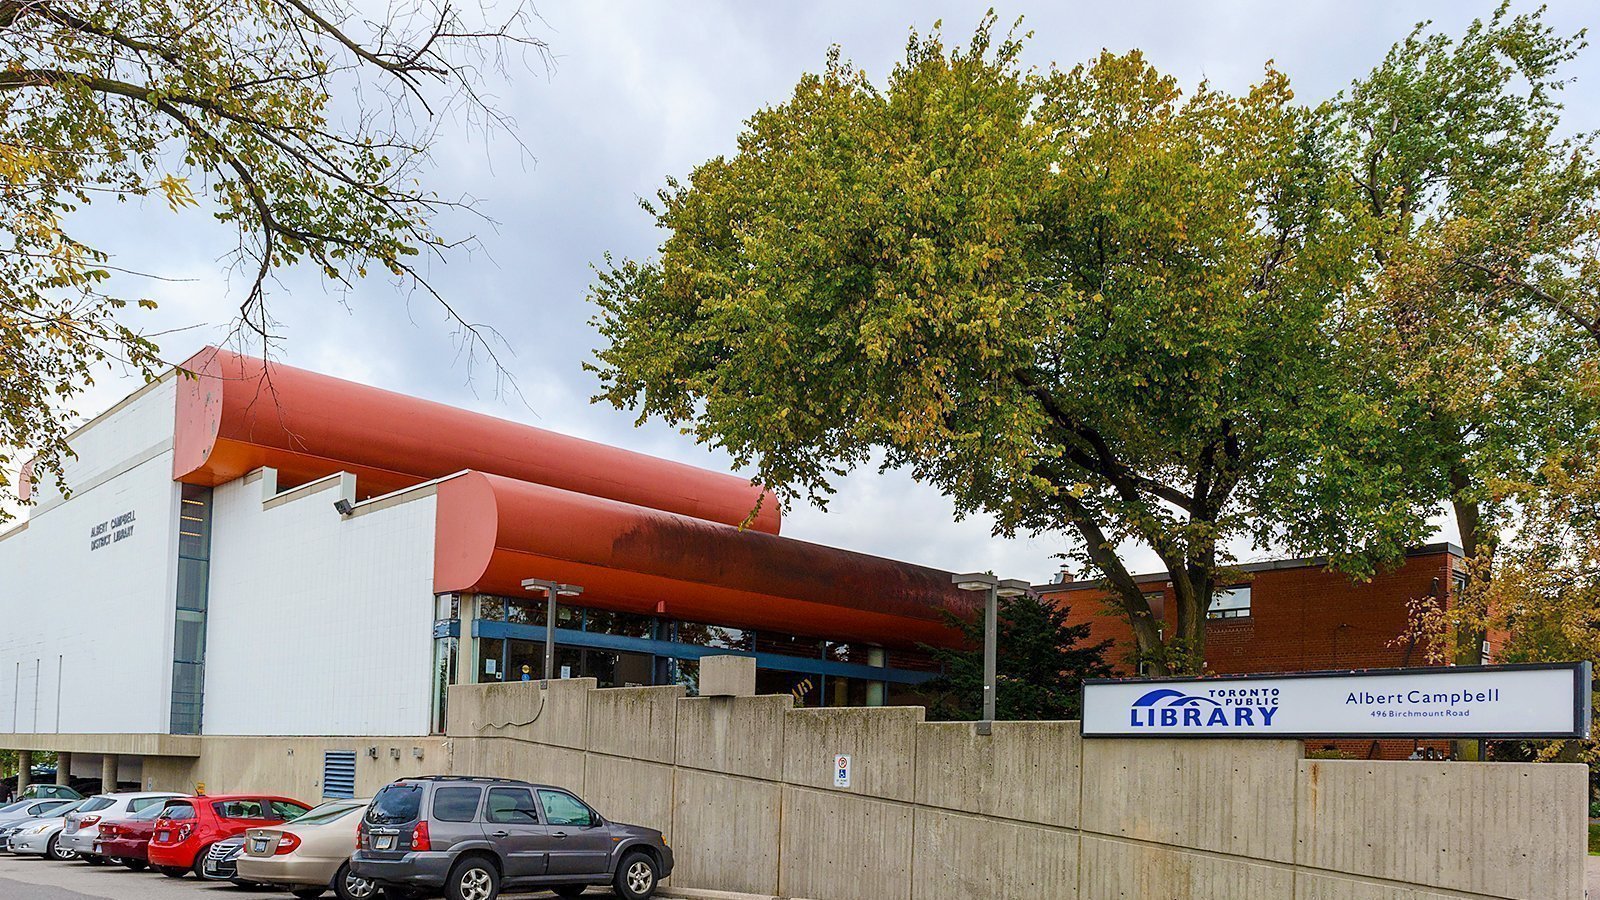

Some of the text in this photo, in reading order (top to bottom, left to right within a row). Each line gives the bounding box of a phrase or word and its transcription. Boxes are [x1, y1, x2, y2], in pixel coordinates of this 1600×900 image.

[91, 510, 136, 538] ALBERT CAMPBELL
[91, 525, 134, 551] DISTRICT LIBRARY
[1208, 688, 1280, 698] TORONTO
[1225, 697, 1279, 706] PUBLIC
[1345, 688, 1500, 706] Albert Campbell
[1130, 706, 1279, 727] LIBRARY
[1370, 709, 1470, 718] 496 Birchmount Road
